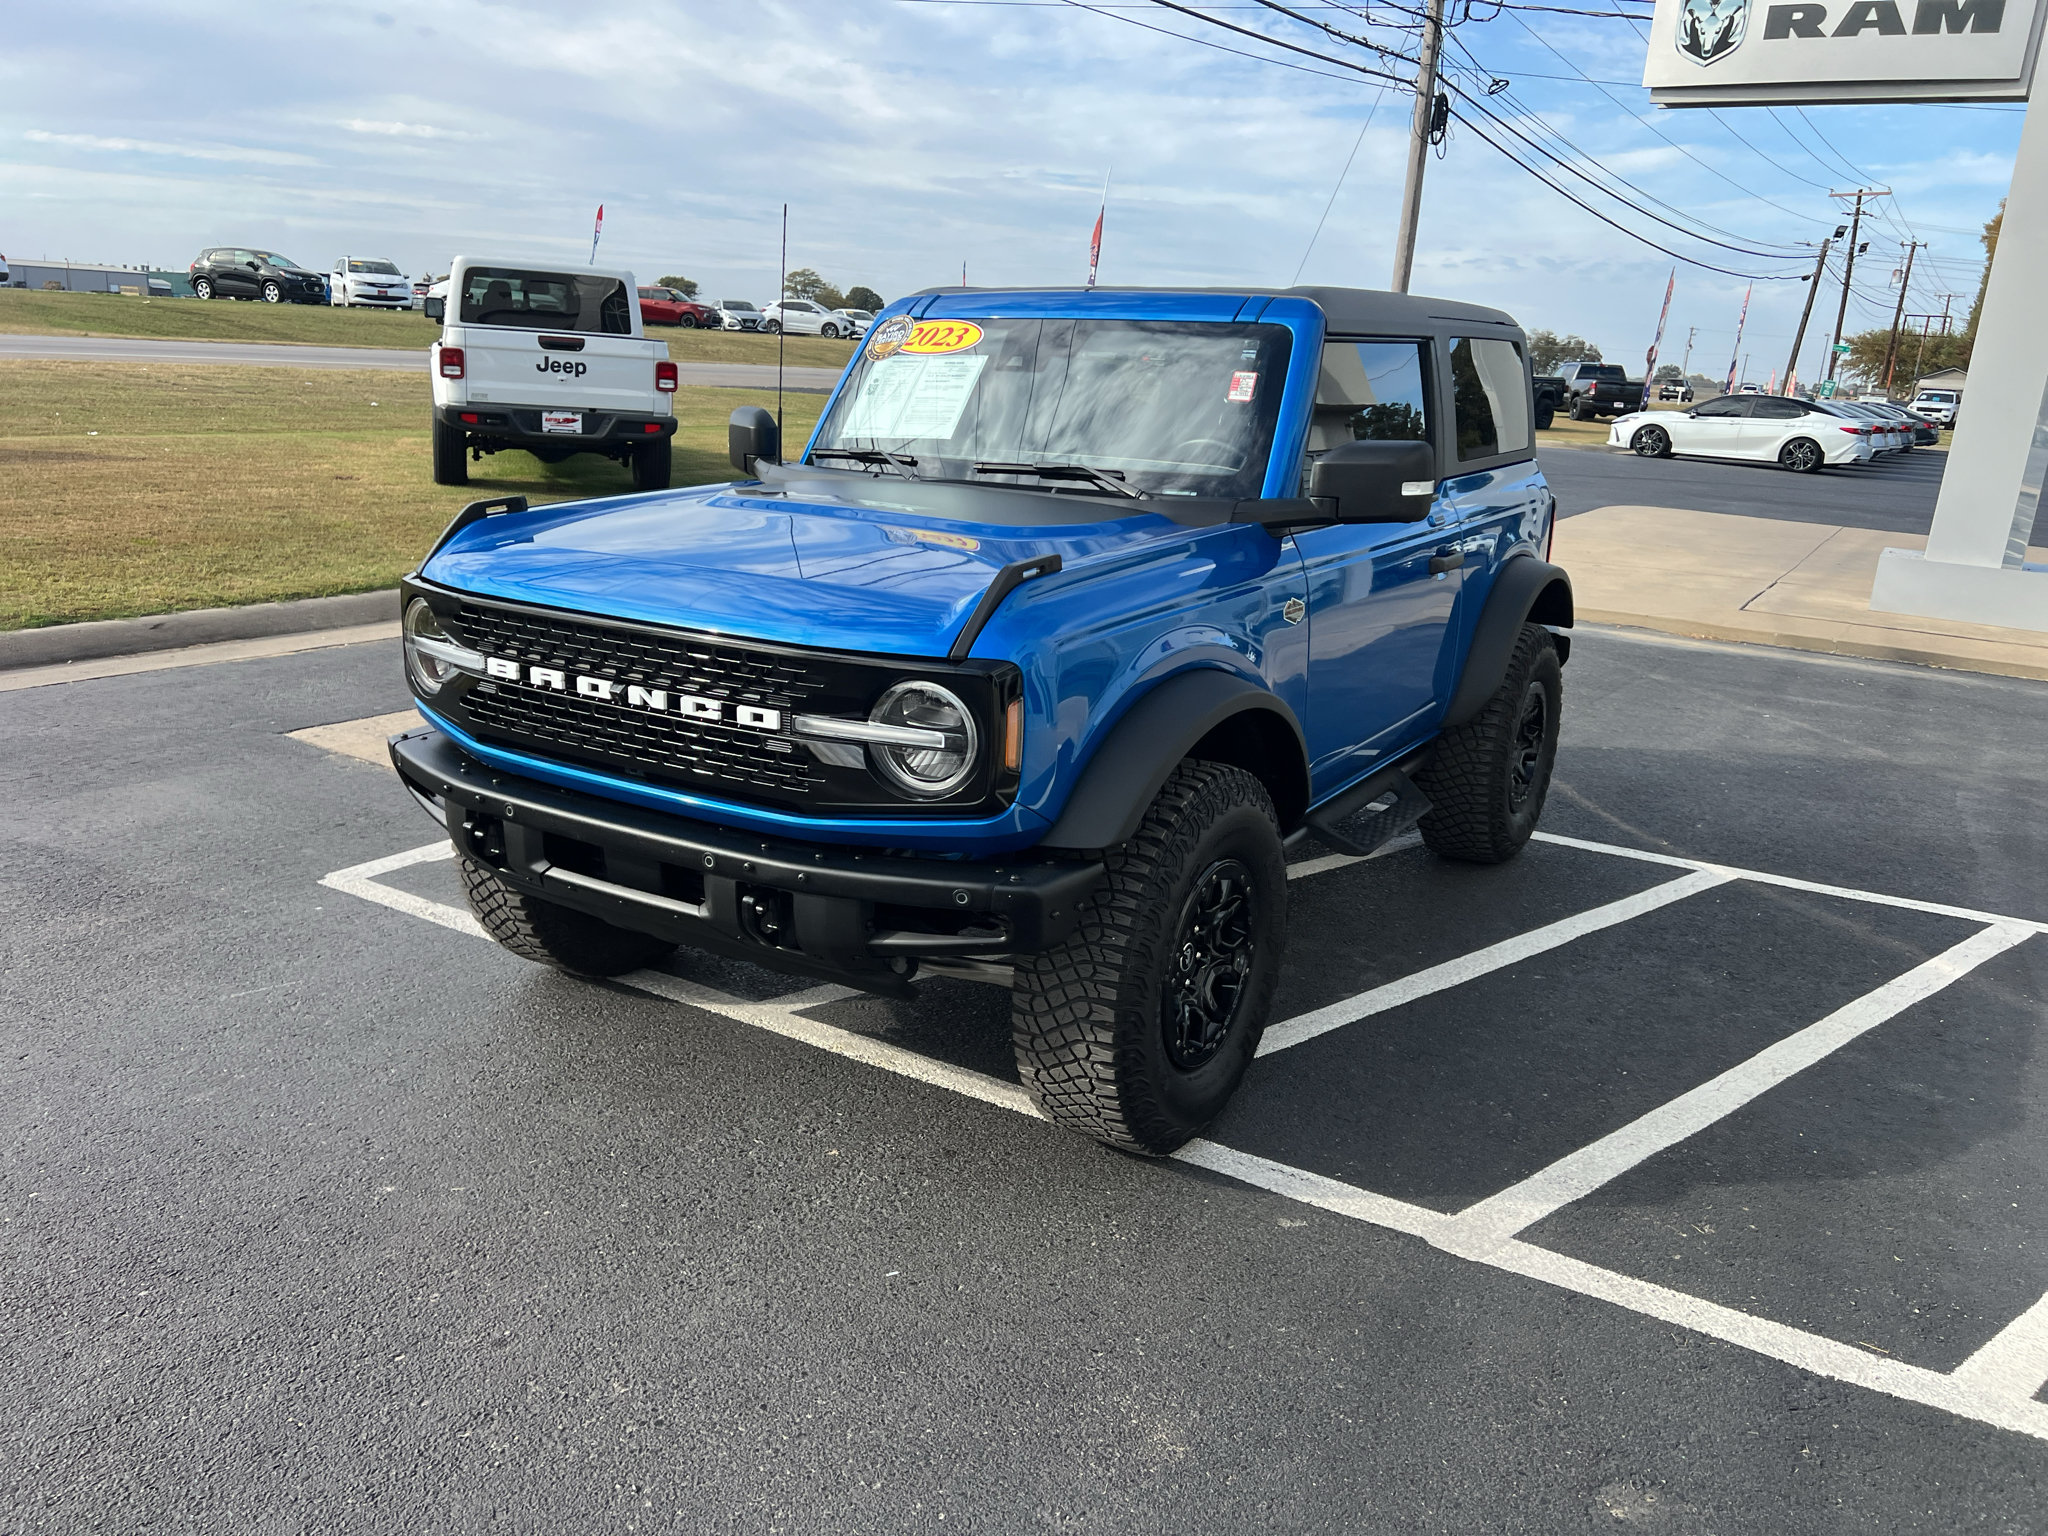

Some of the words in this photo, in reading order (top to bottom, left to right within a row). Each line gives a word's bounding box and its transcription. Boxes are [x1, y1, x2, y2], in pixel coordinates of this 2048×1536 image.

[1763, 0, 2006, 40] RAM
[904, 327, 970, 347] 2023
[536, 355, 587, 378] Jeep
[487, 656, 781, 731] BRONCO
